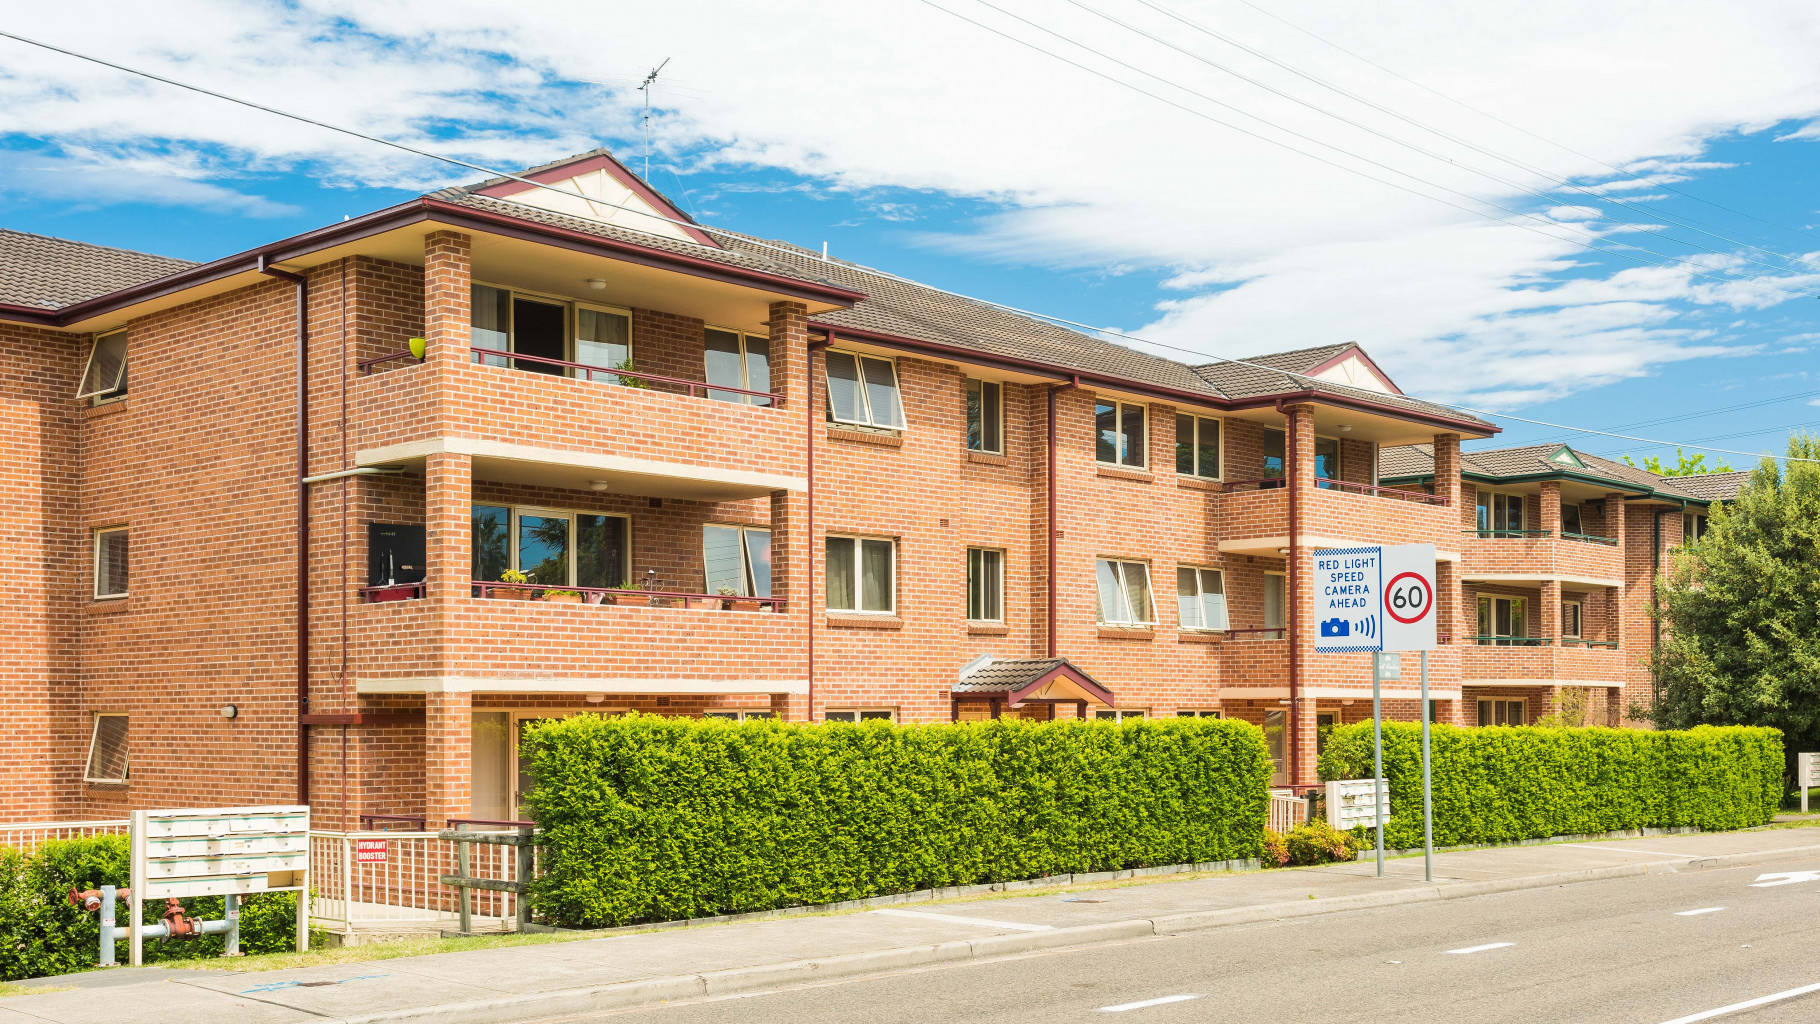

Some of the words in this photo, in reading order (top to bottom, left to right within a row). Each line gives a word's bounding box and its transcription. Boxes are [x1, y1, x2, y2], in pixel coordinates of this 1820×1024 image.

[1319, 560, 1339, 570] RED
[1345, 558, 1375, 569] LIGHT
[1331, 572, 1364, 582] SPEED
[1325, 585, 1369, 595] CAMERA
[1393, 586, 1422, 608] 60
[1329, 598, 1366, 608] AHEAD
[359, 852, 386, 860] BOOSTER
